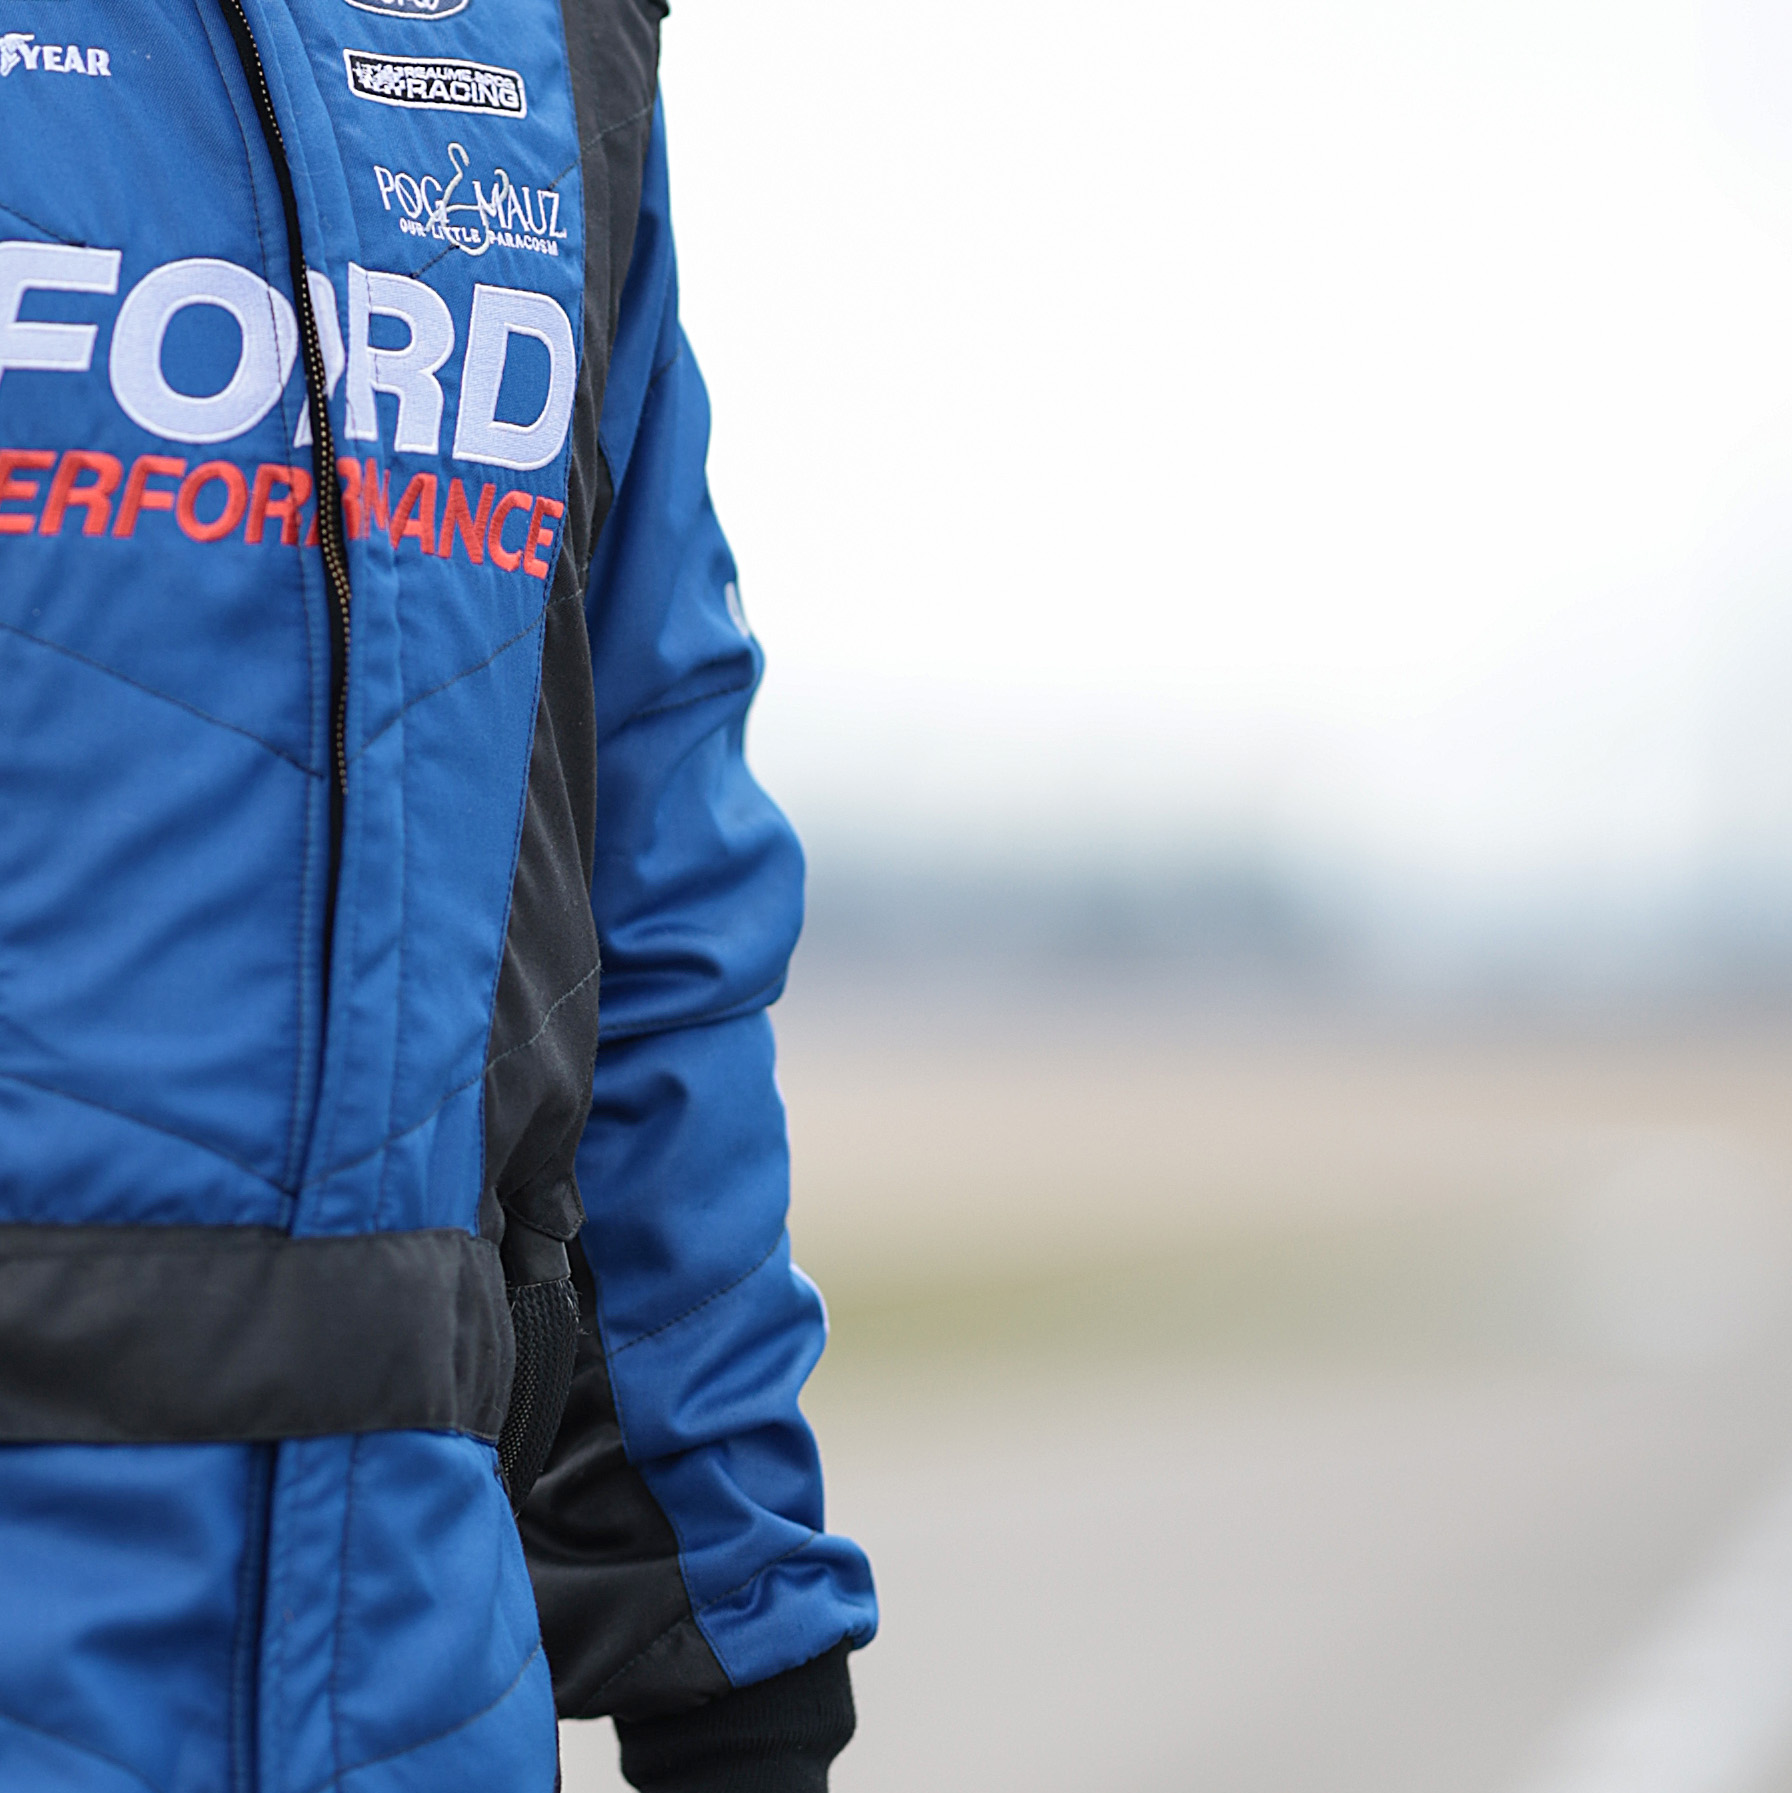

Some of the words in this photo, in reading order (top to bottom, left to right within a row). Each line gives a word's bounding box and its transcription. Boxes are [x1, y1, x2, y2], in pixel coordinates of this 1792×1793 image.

[407, 78, 519, 107] RACING
[399, 218, 427, 238] OUR
[431, 225, 482, 244] LITTLE
[487, 230, 560, 257] PARACOSM
